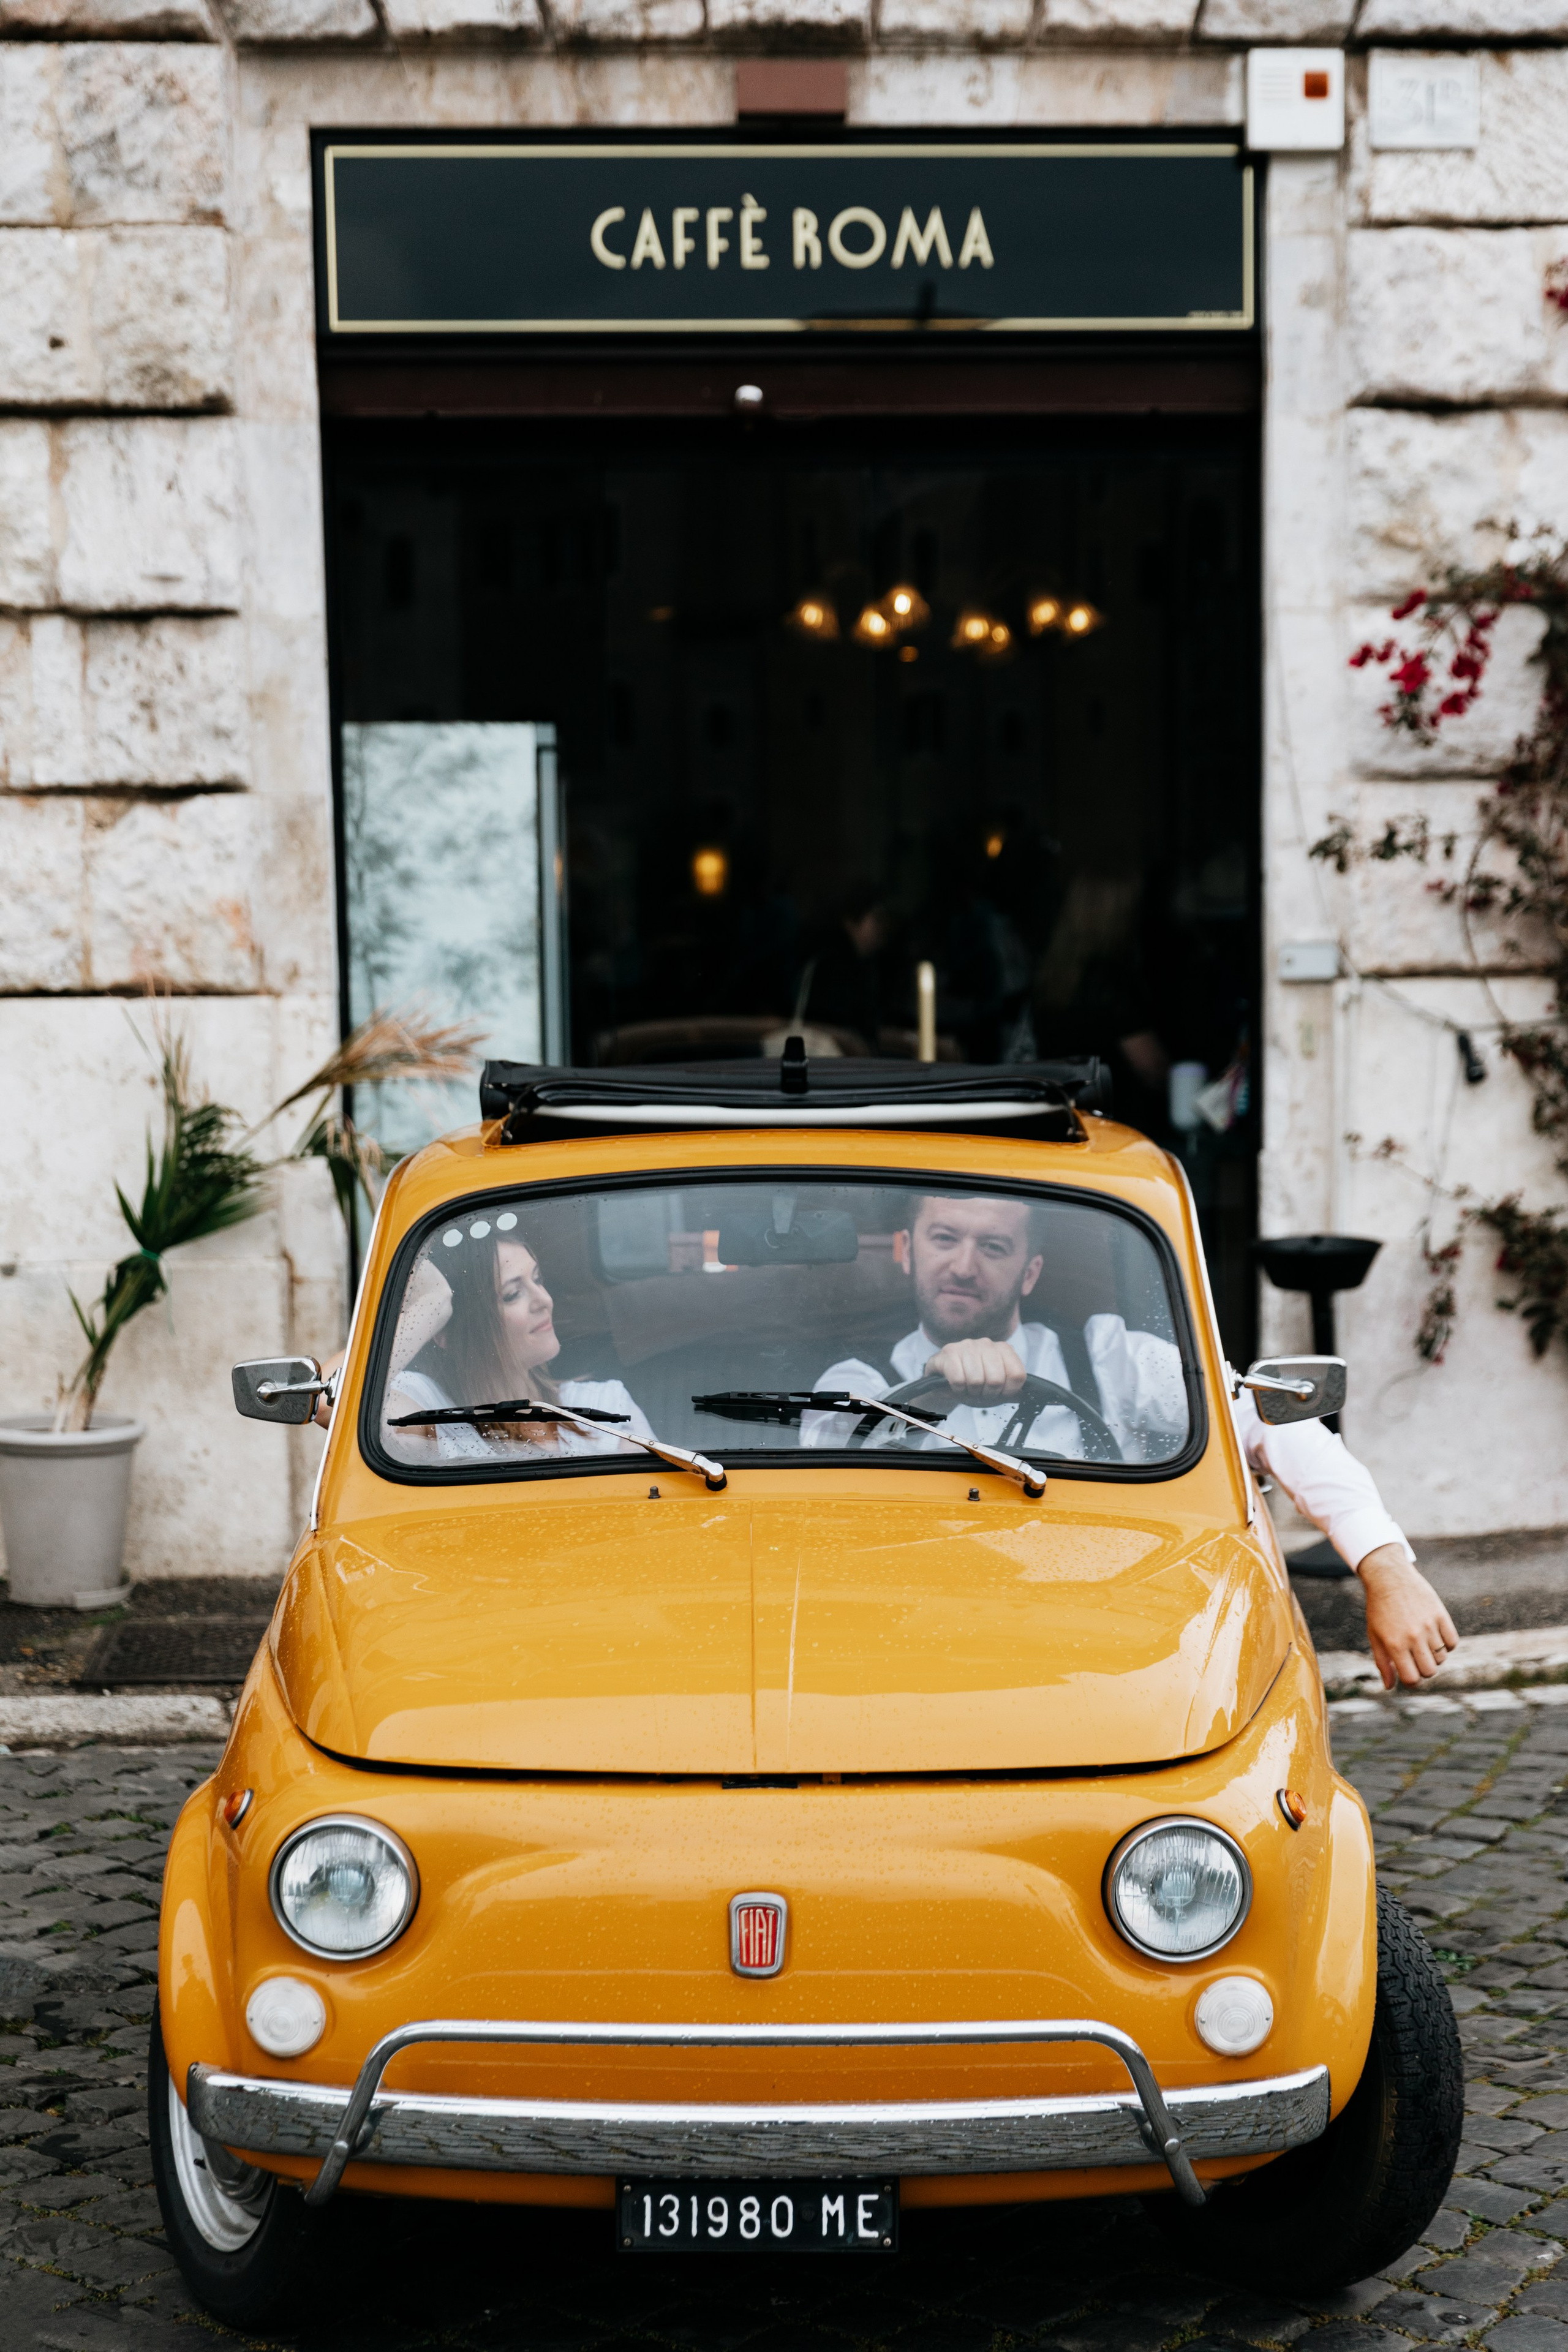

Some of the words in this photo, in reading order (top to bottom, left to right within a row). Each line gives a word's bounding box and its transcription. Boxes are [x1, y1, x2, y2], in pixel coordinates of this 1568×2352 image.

[590, 192, 771, 270] CAFFÈ
[792, 205, 995, 270] ROMA
[741, 1908, 775, 1965] FIAT
[643, 2193, 794, 2239] 131980
[821, 2194, 880, 2238] ME
